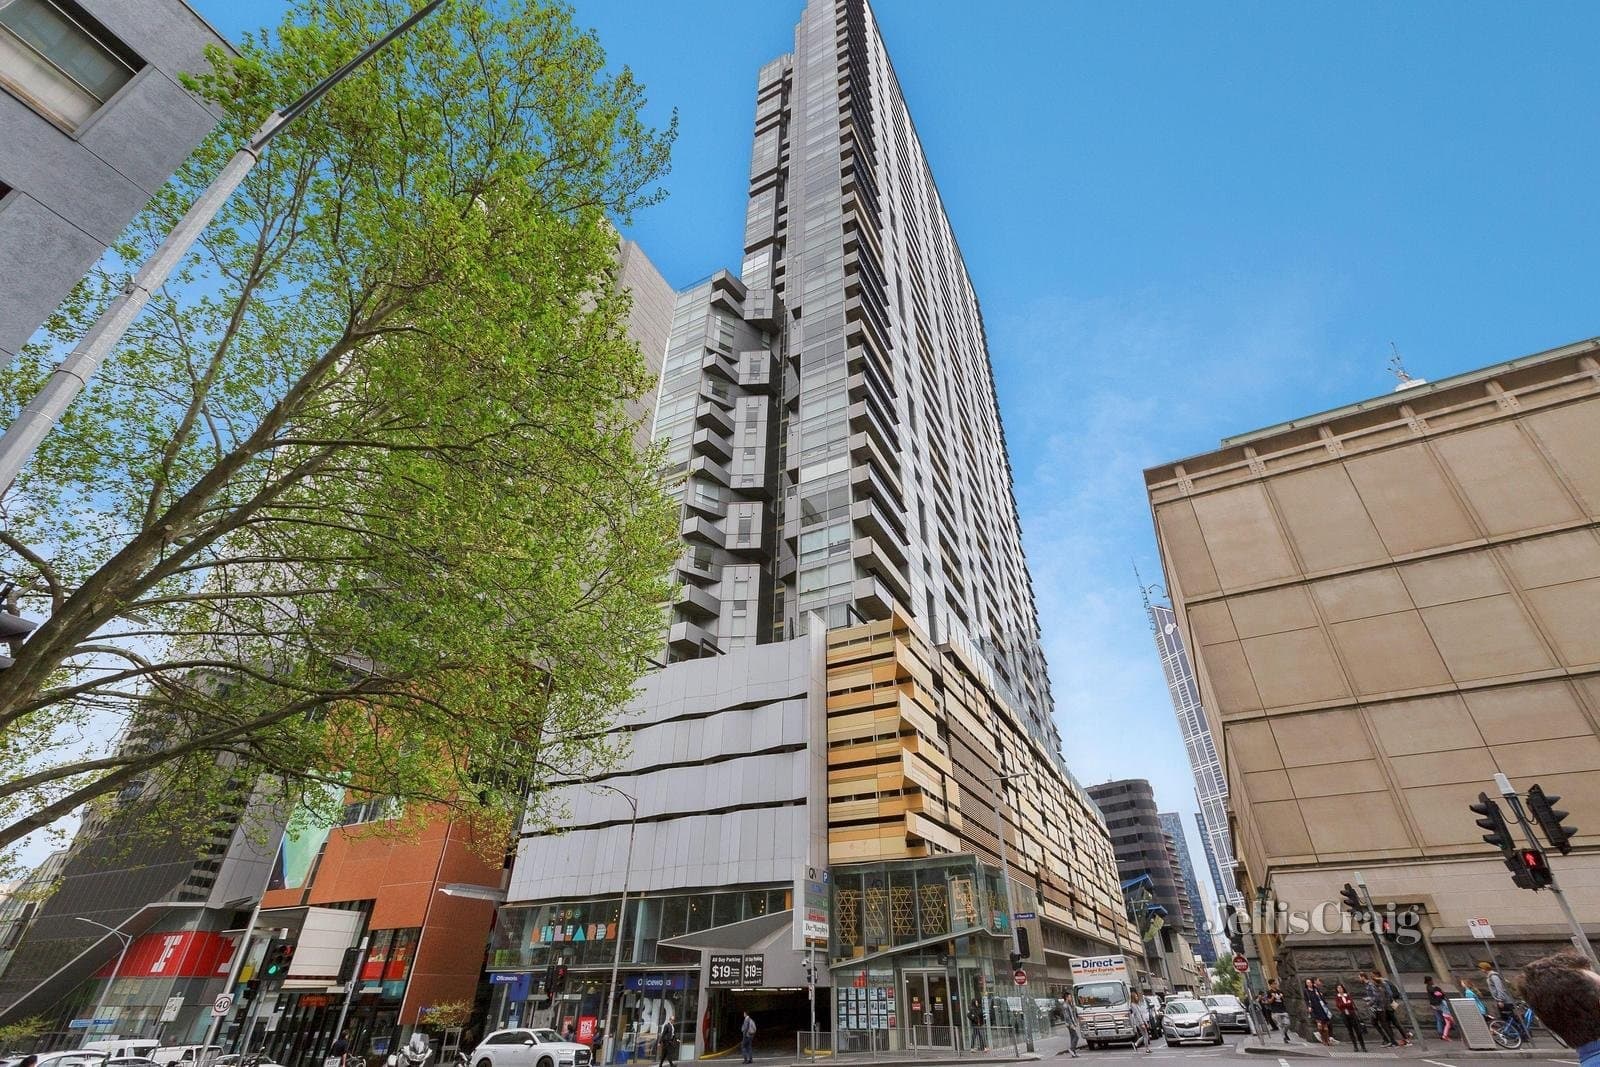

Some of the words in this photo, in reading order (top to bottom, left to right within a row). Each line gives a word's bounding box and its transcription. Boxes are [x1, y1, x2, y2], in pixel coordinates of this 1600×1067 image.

[823, 872, 828, 882] P
[1082, 959, 1113, 969] Direct
[711, 964, 731, 979] $19
[744, 964, 757, 978] $19
[216, 1001, 230, 1009] 40
